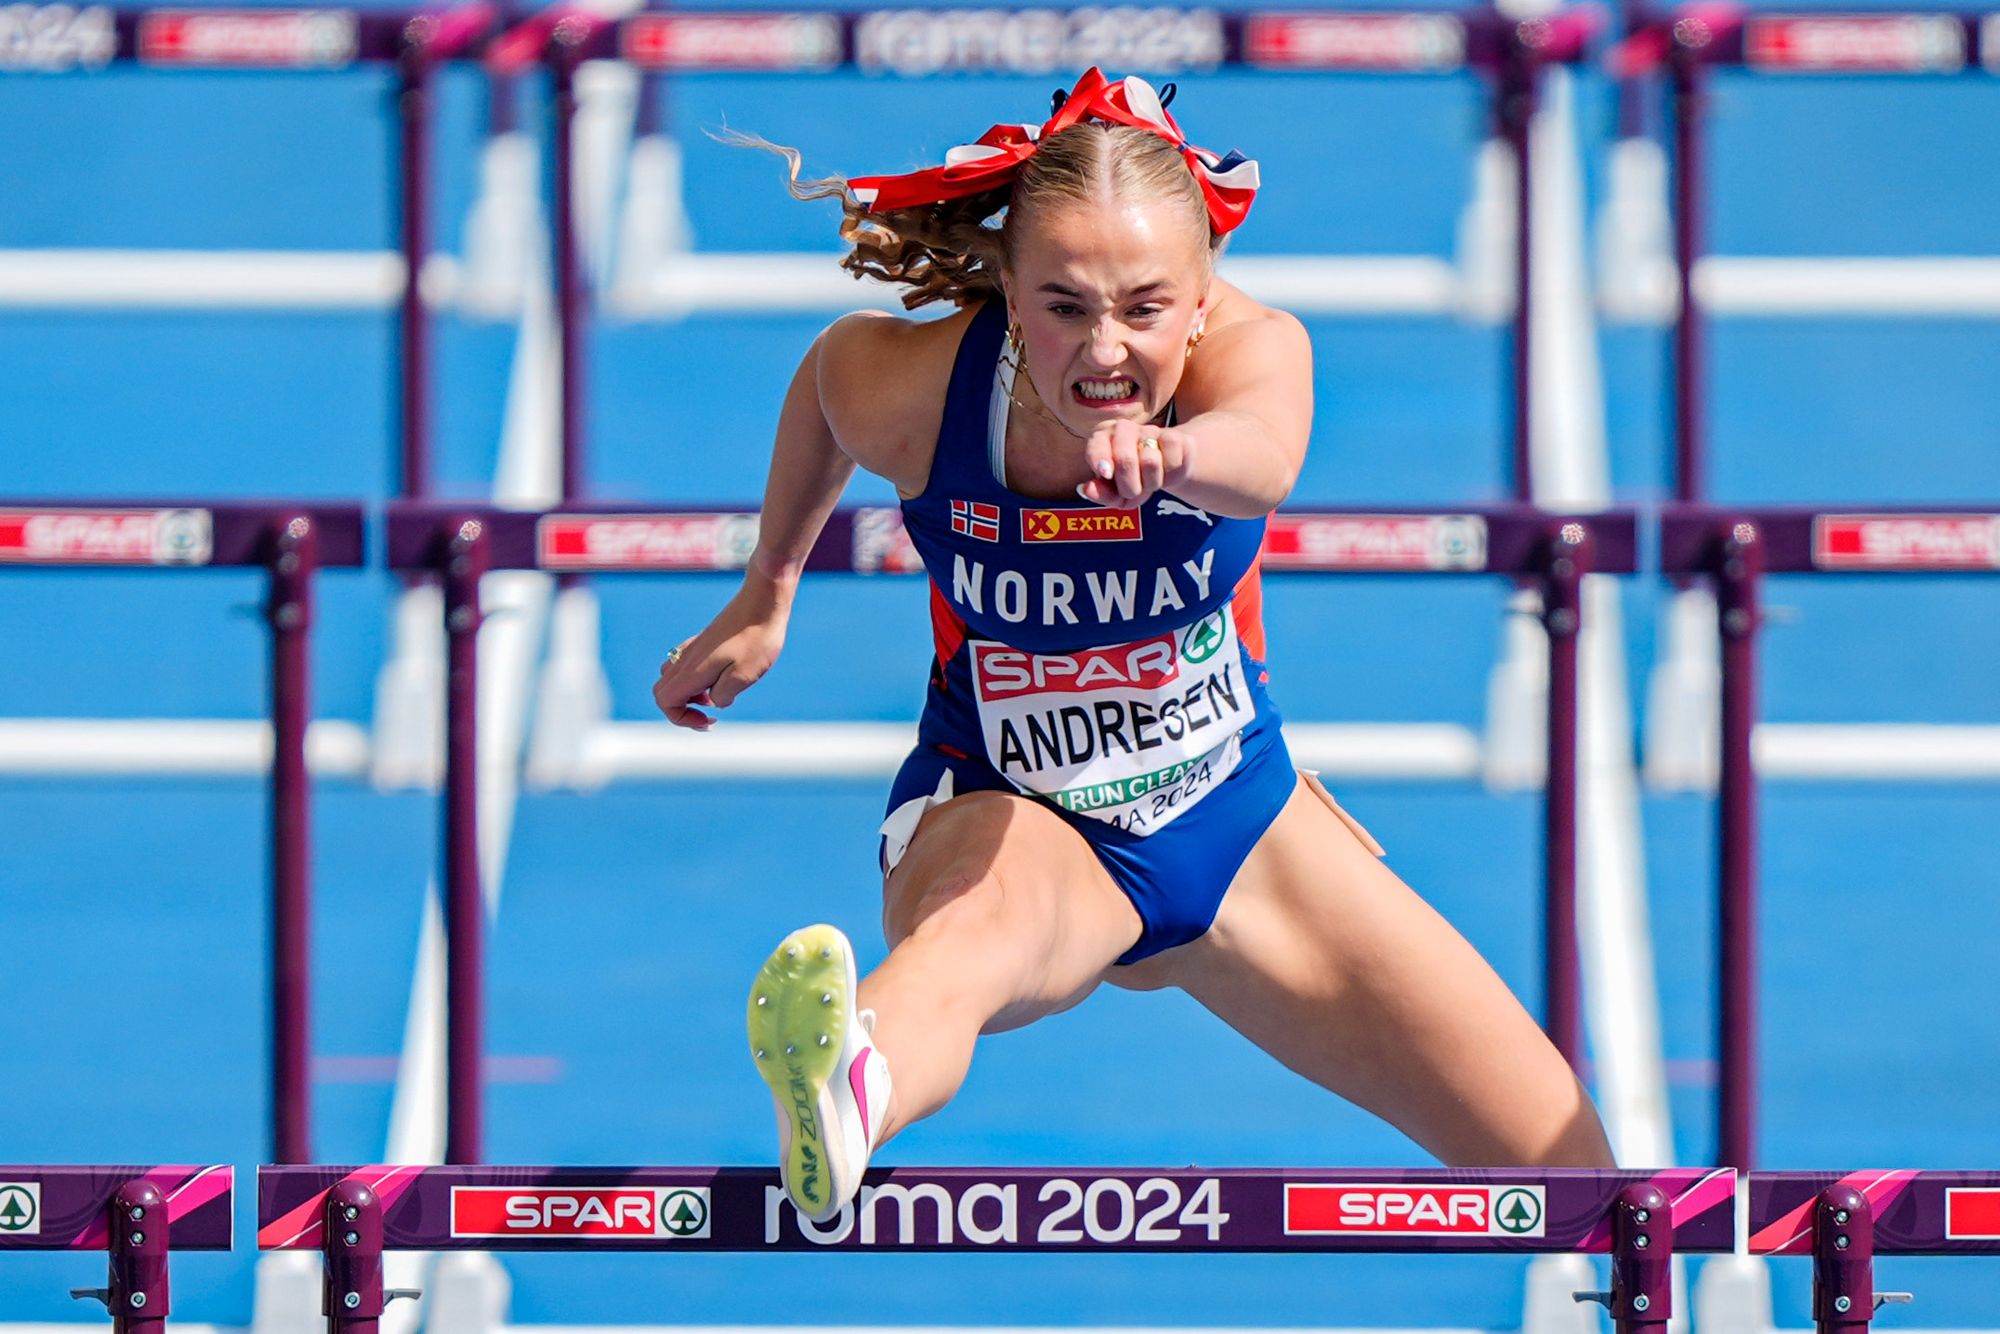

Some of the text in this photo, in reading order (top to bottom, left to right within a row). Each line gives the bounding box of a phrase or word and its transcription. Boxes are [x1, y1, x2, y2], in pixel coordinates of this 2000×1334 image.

[1067, 516, 1135, 531] EXTRA
[953, 549, 1215, 625] NORWAY
[983, 645, 1175, 691] SPAR
[1000, 664, 1240, 774] ANDRESEN
[1069, 783, 1124, 812] RUN
[1152, 760, 1212, 818] 2024
[505, 1196, 651, 1228] SPAR
[1037, 1177, 1230, 1243] 2024
[1338, 1193, 1485, 1227] SPAR
